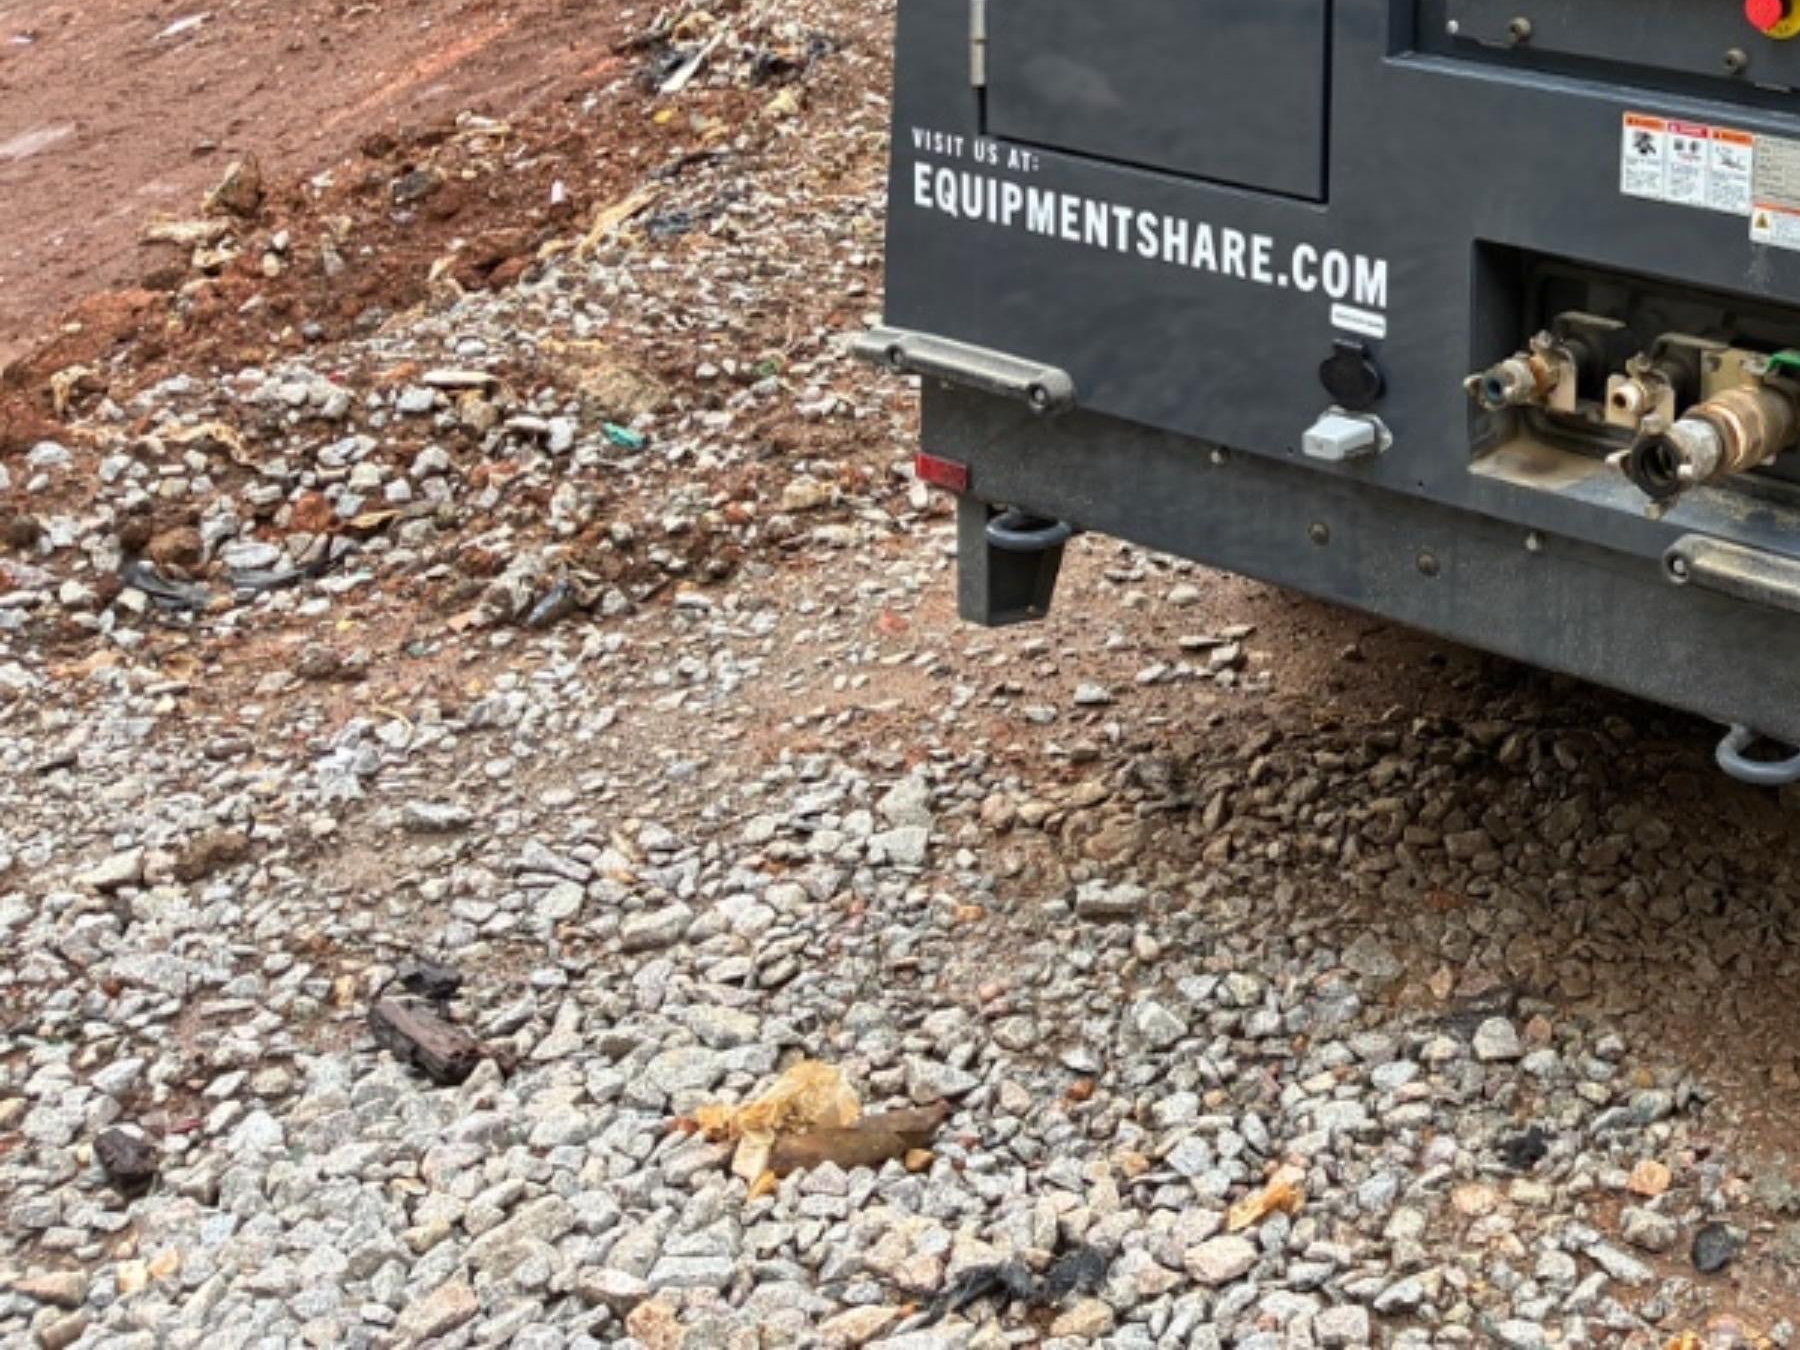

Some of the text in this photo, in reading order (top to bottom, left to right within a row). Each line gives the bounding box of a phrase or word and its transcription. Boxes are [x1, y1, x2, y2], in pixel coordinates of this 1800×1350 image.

[911, 127, 1039, 172] VISIT US AT:
[913, 161, 1388, 308] EQUIPMENTSHARE.COM
